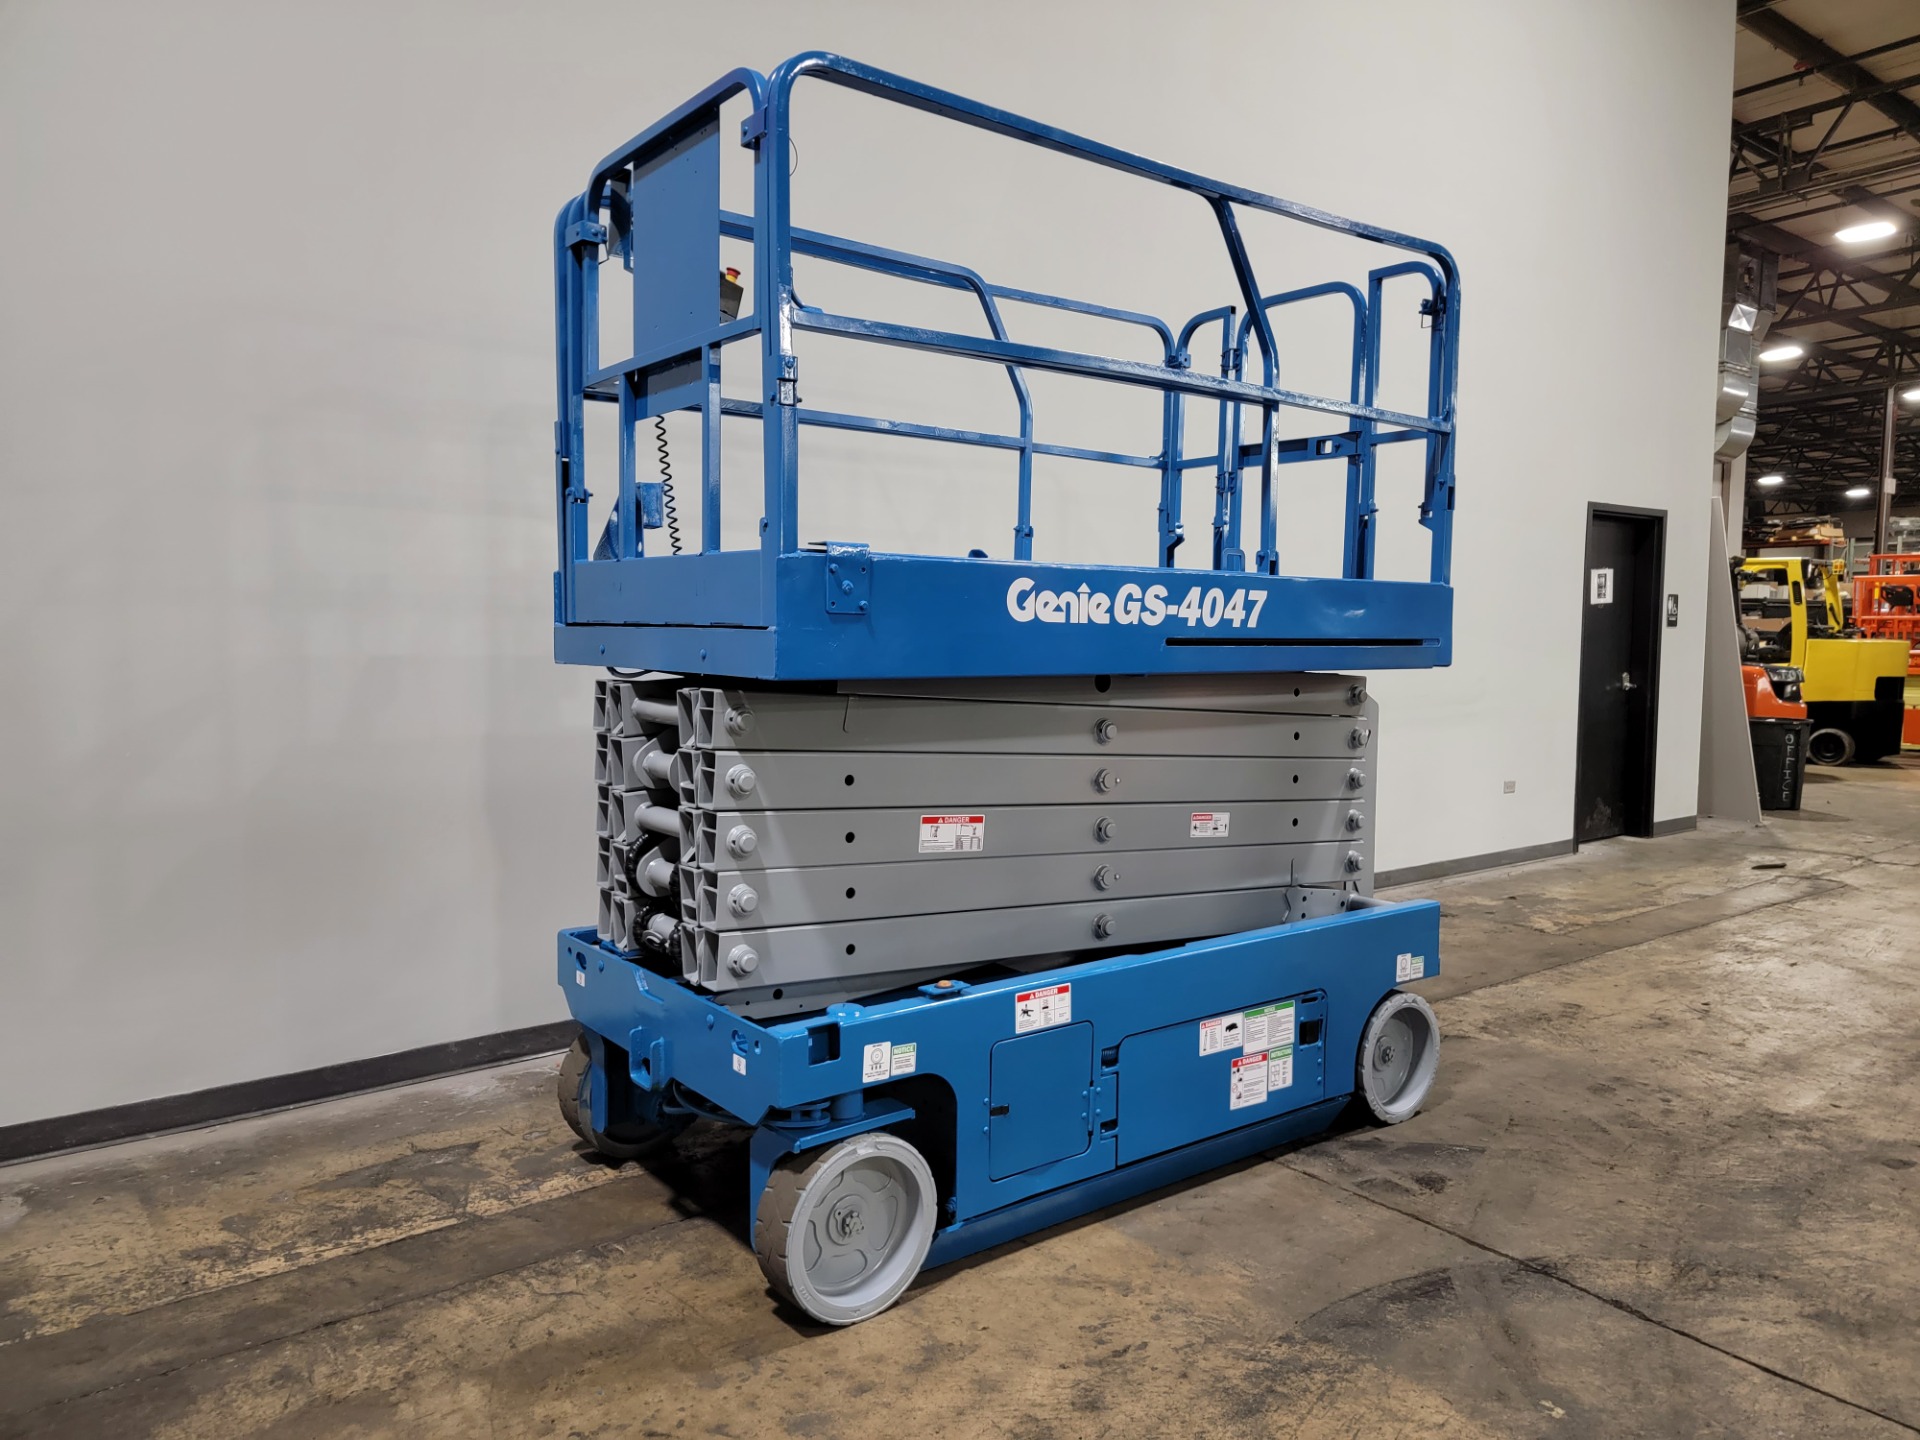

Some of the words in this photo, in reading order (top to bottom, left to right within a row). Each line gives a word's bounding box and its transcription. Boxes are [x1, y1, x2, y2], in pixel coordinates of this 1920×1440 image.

[1006, 577, 1111, 624] Genie
[1114, 583, 1268, 628] GS-4047
[1782, 733, 1795, 801] OFFICE
[1035, 988, 1059, 998] DANGER
[893, 1044, 914, 1055] NOTICE
[1242, 1054, 1263, 1065] DANGER
